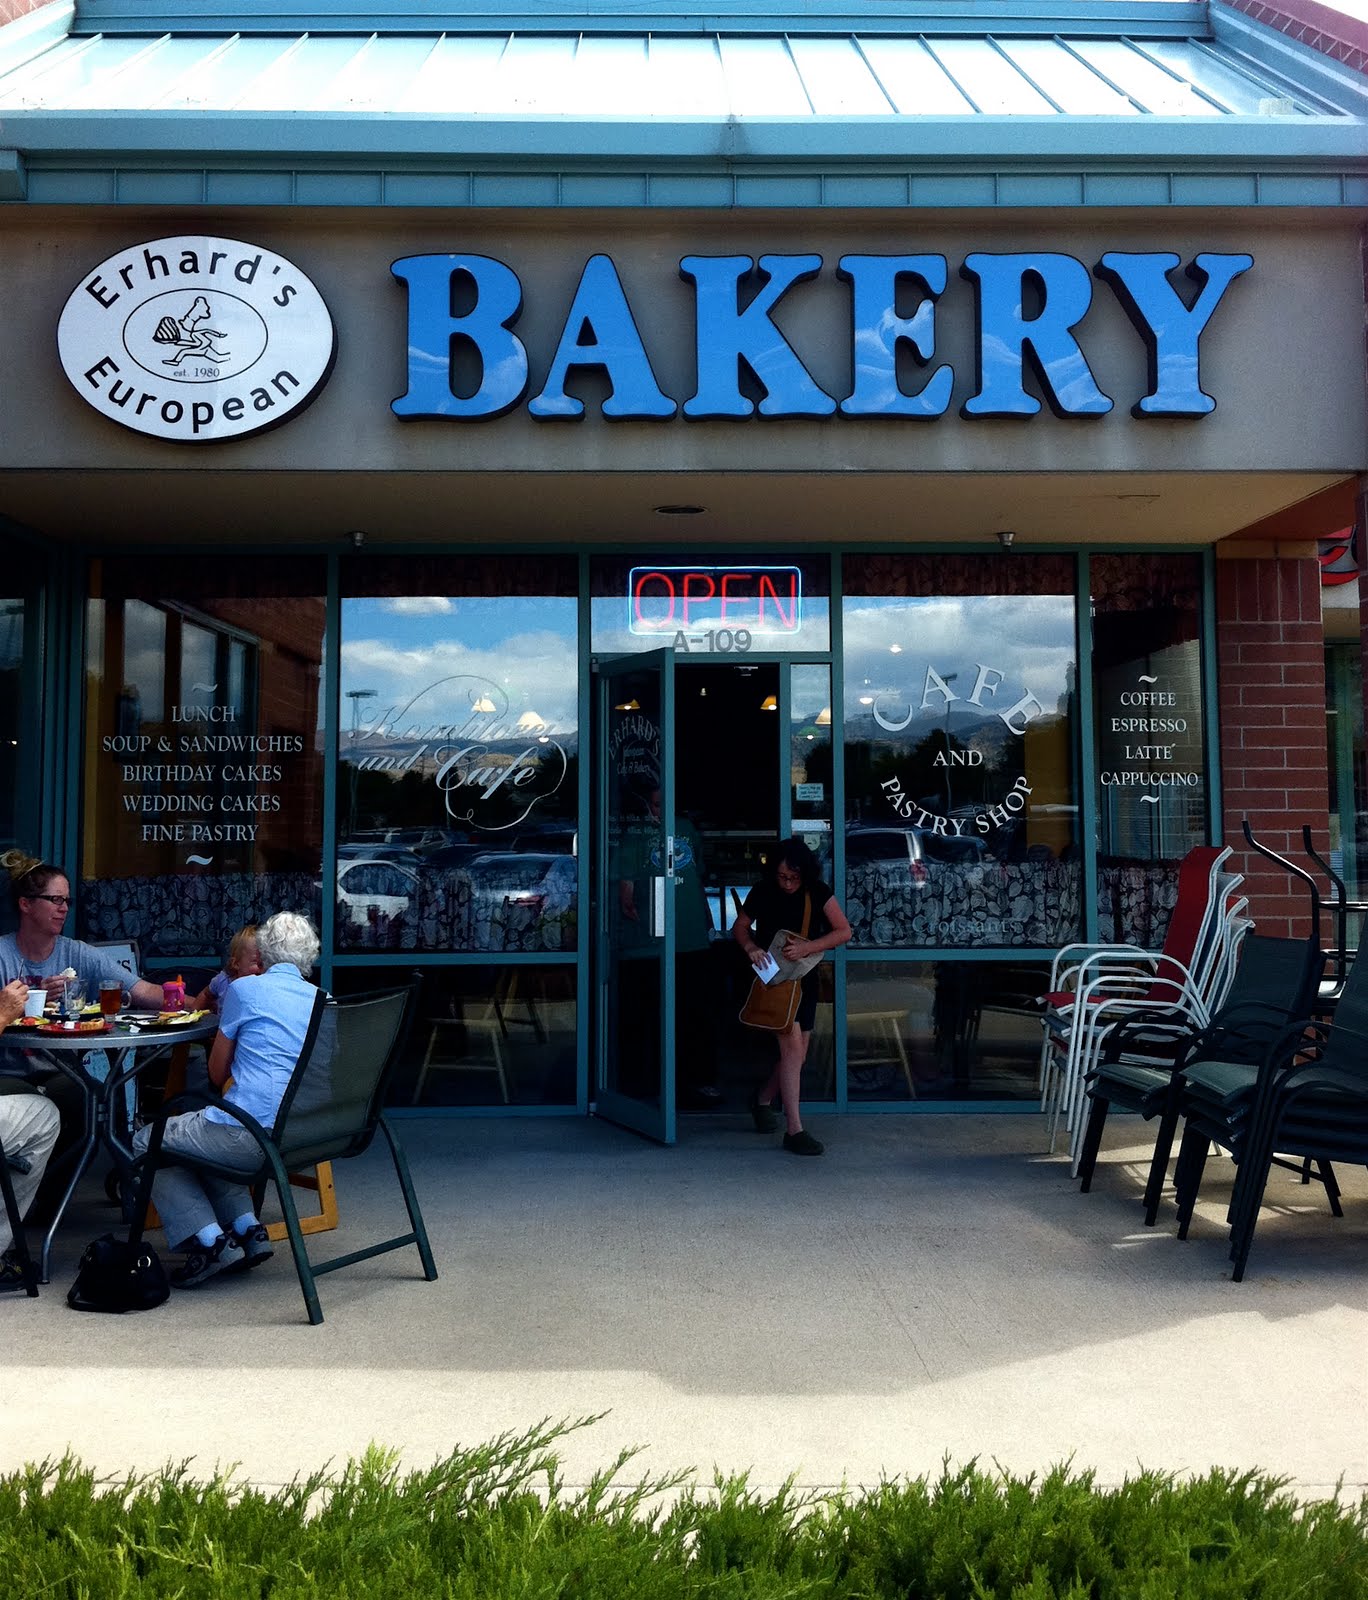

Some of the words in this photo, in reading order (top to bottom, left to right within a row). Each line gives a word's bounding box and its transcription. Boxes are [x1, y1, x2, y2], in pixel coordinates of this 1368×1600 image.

[86, 249, 297, 309] Erhard's
[390, 252, 1254, 421] BAKERY
[173, 368, 190, 378] est.
[194, 367, 220, 378] 1980
[84, 355, 300, 433] European
[634, 572, 797, 628] OPEN
[672, 629, 752, 652] A-109
[872, 662, 1045, 735] CAFE
[1120, 691, 1176, 706] COFFEE
[171, 705, 236, 722] LUNCH
[1111, 718, 1187, 733] ESPRESSO
[102, 735, 151, 752] SOUP
[157, 735, 173, 752] &
[180, 735, 303, 752] SANDWICHES
[358, 744, 428, 771] und
[933, 750, 983, 766] AND
[123, 764, 216, 782] BIRTHDAY
[221, 764, 282, 782] CAKES
[1100, 771, 1199, 786] CAPPUCCINO
[123, 795, 214, 812] WEDDING
[220, 795, 280, 812] CAKES
[880, 775, 966, 836] PASTRY
[975, 776, 1033, 833] SHOP
[142, 824, 184, 841] FINE
[191, 824, 259, 841] PASTRY
